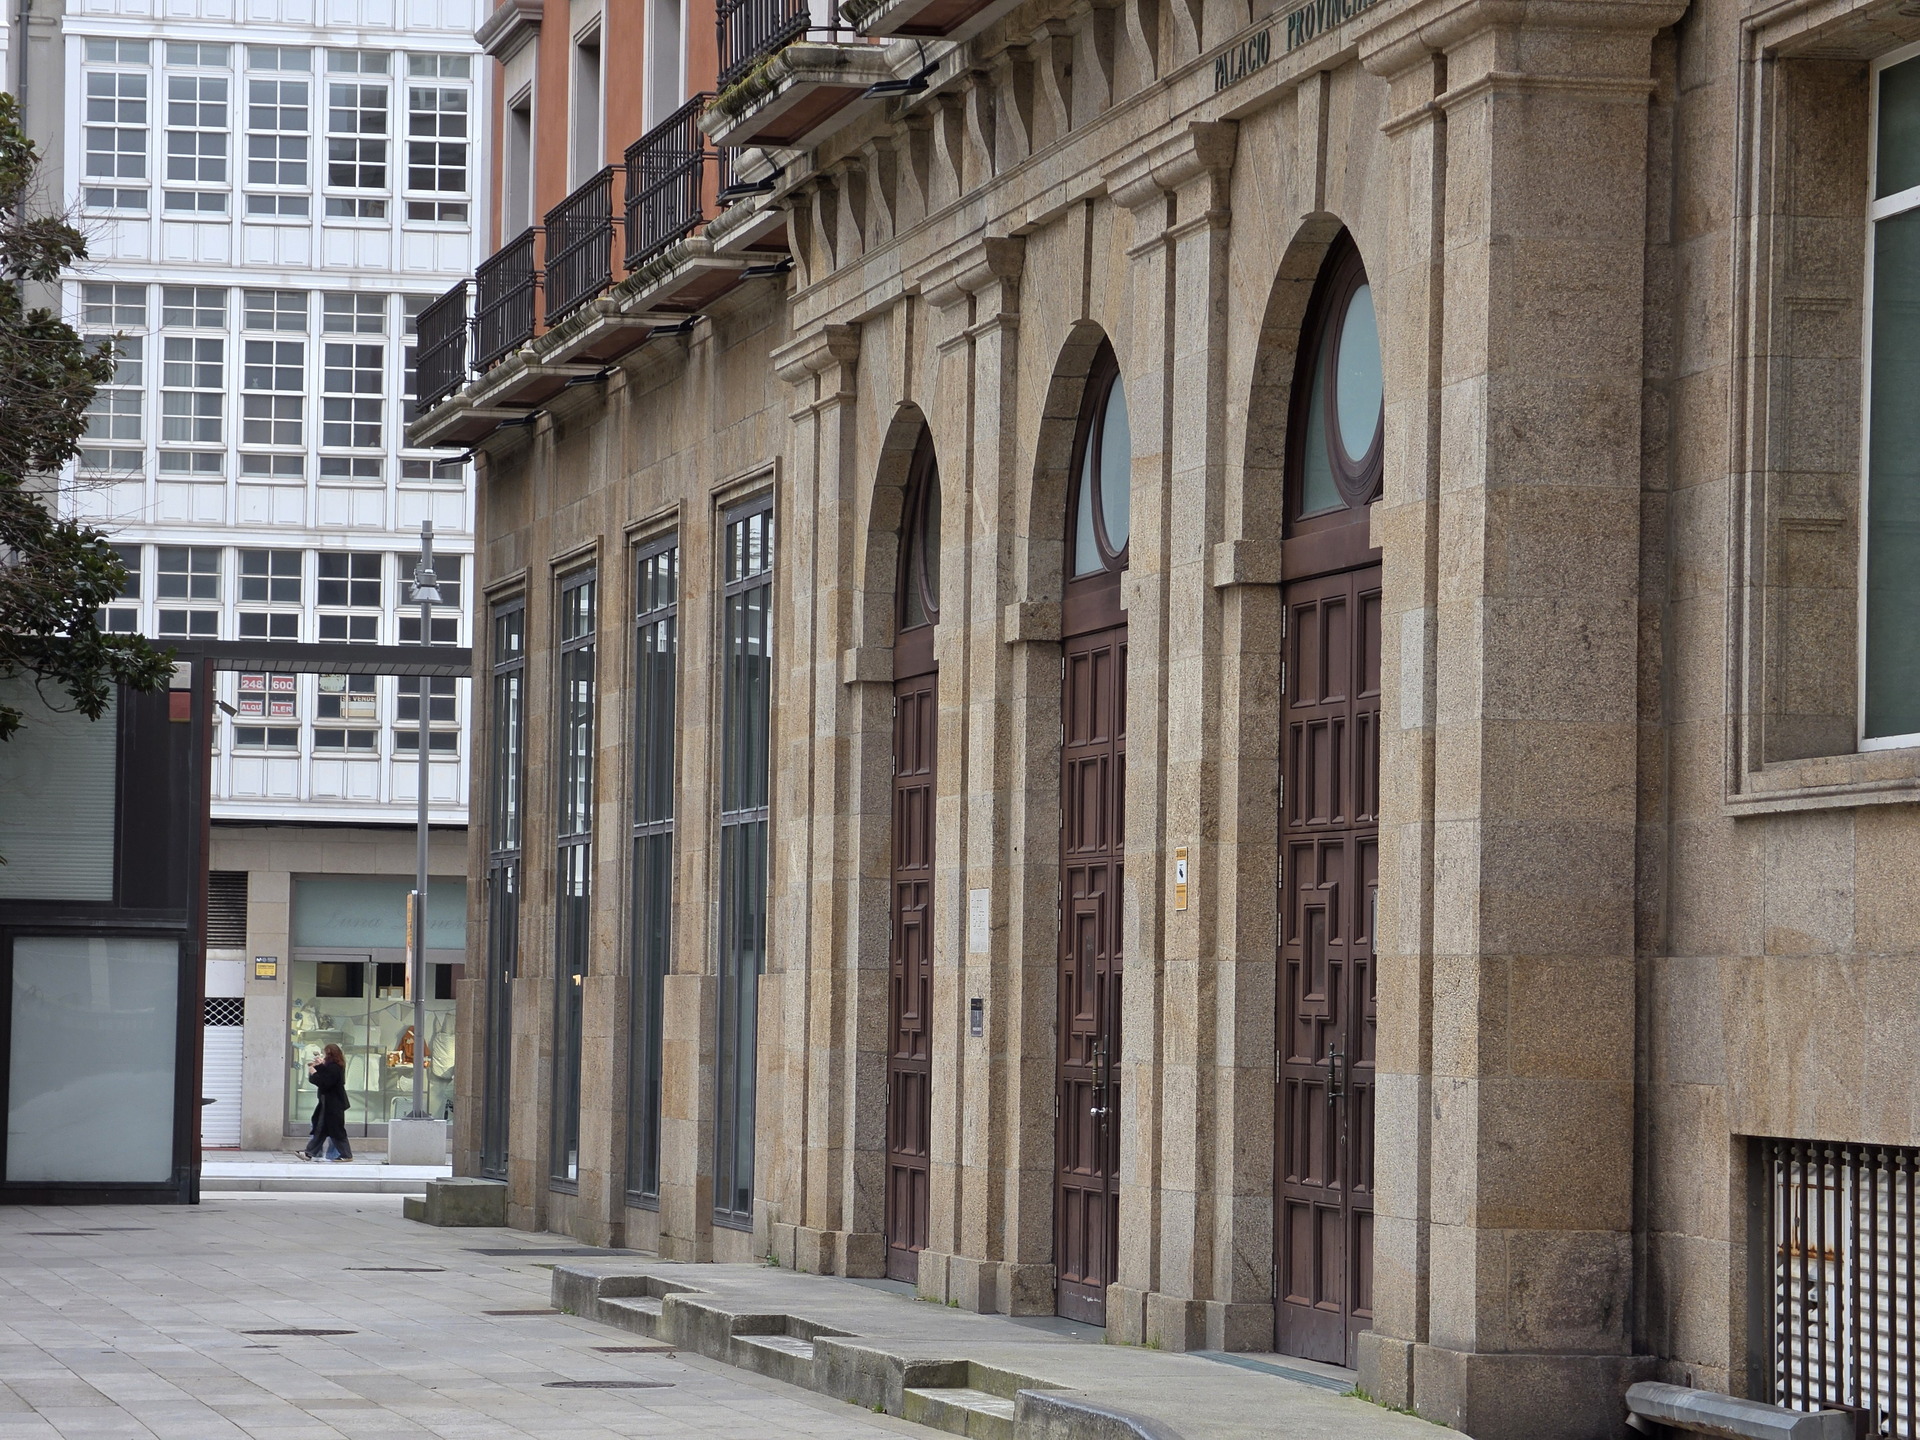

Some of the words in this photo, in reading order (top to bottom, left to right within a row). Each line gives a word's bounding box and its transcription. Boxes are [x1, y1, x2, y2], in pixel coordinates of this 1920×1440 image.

[1213, 29, 1271, 92] PALACIO
[1286, 0, 1378, 52] PROVIN
[242, 680, 262, 689] 248
[273, 681, 293, 690] 600
